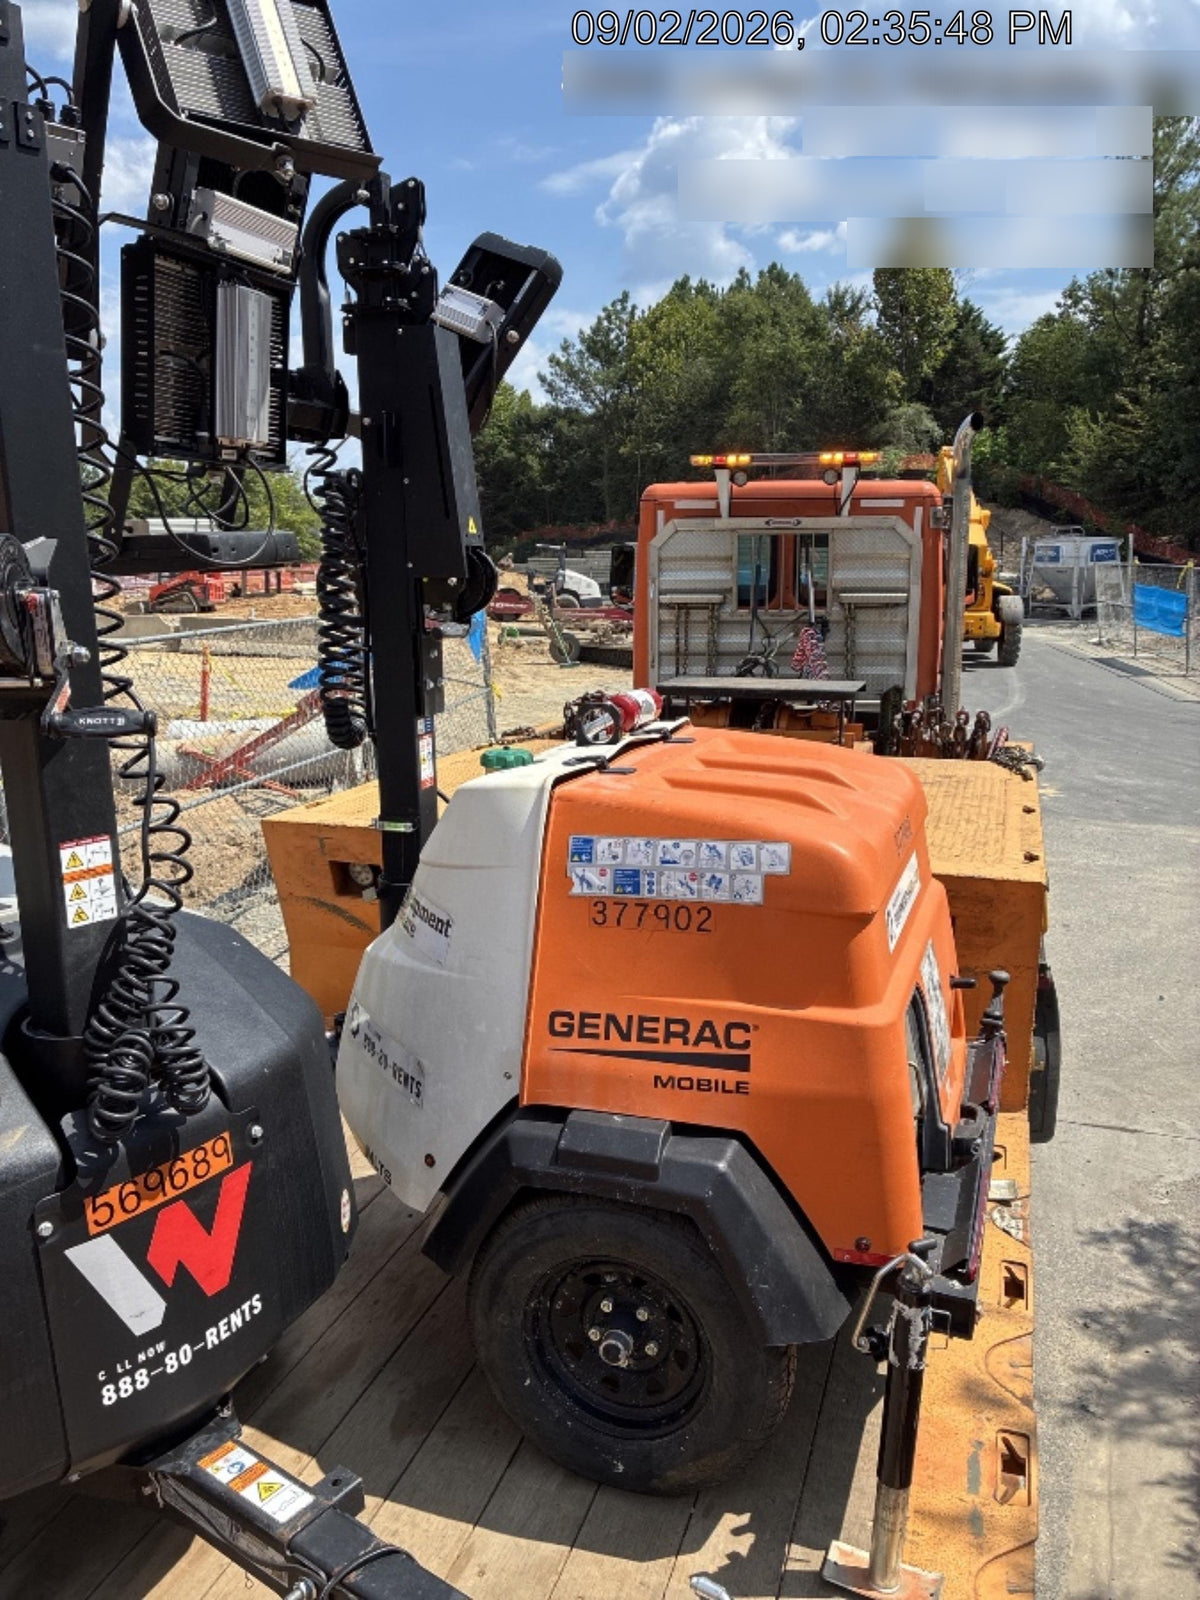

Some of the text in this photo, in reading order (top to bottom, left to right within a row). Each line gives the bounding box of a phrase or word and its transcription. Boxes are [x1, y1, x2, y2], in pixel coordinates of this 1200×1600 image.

[591, 901, 712, 932] 377902
[548, 1010, 751, 1050] GENERAC
[653, 1075, 750, 1095] MOBILE
[91, 1135, 232, 1227] 569689
[100, 1293, 263, 1406] 888-80-RENTS
[137, 1340, 167, 1363] NOW
